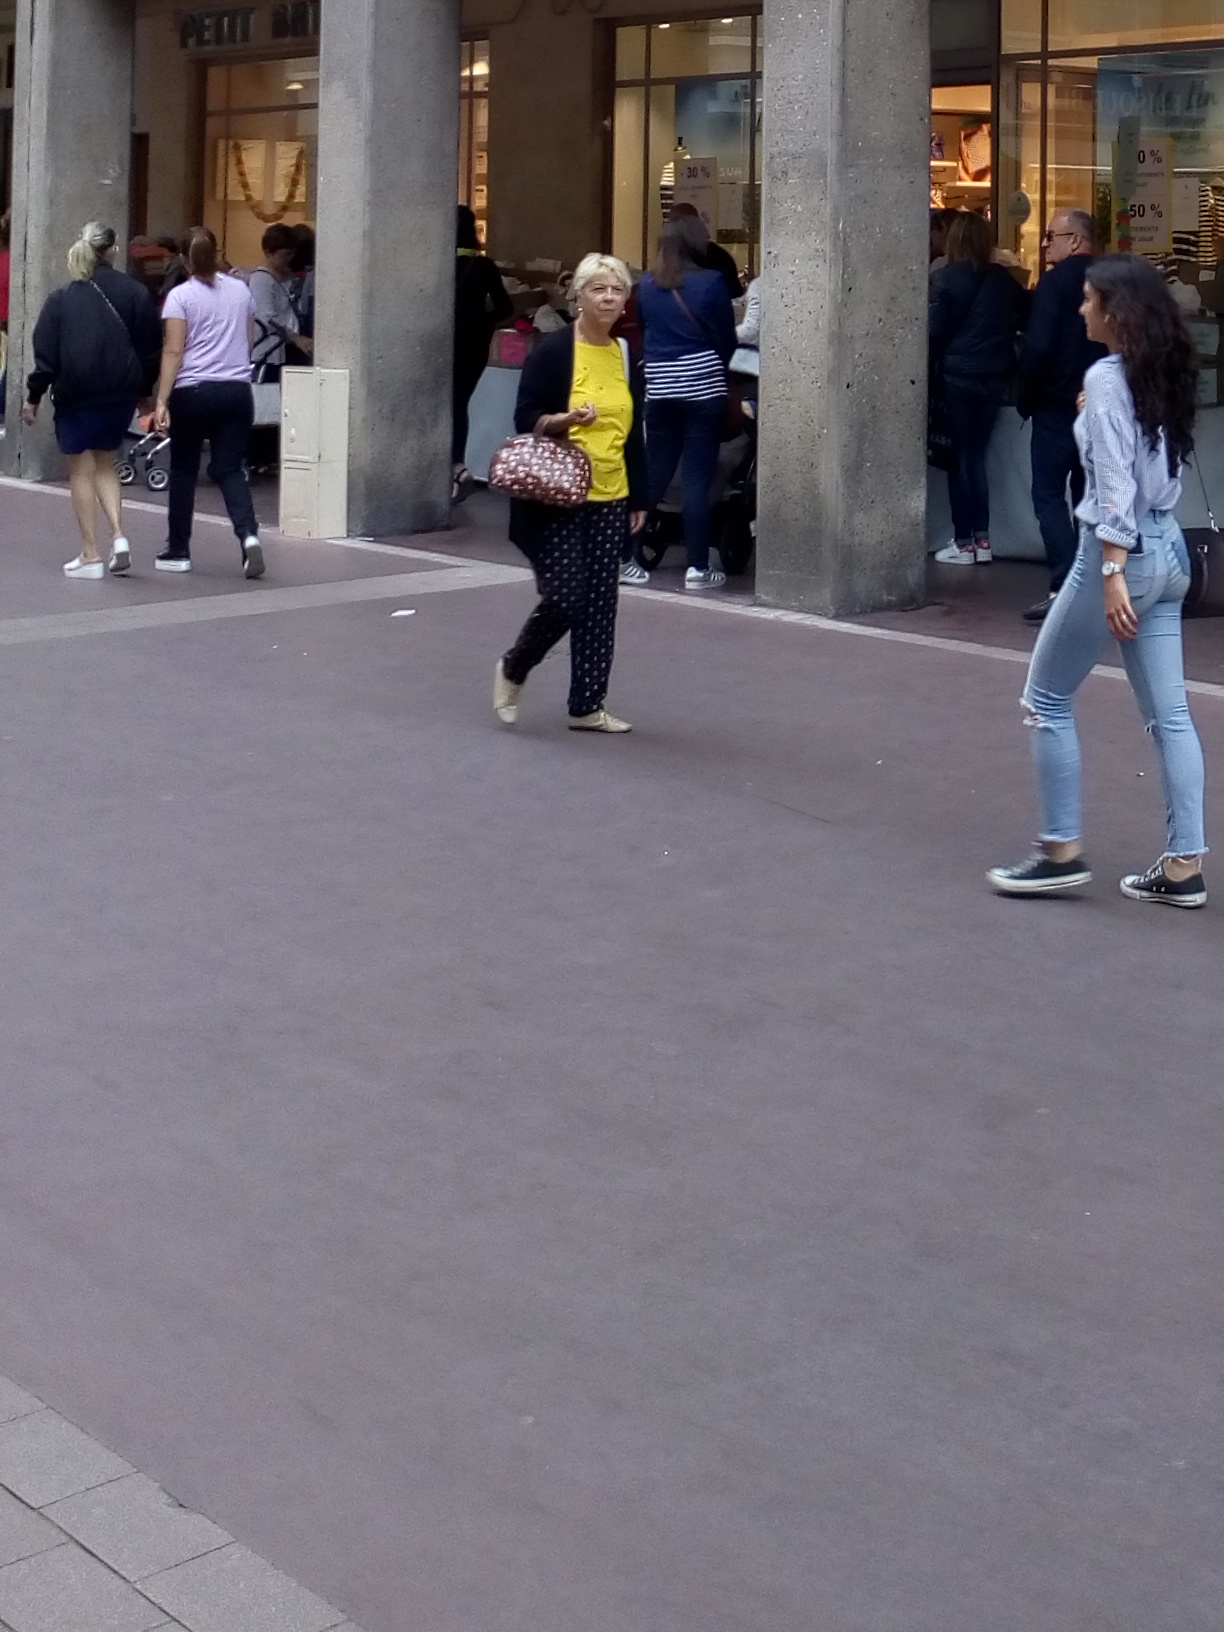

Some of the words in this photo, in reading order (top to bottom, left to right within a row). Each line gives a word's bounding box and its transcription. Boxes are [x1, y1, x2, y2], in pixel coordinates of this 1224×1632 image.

[1150, 149, 1163, 164] %
[1129, 204, 1146, 218] 50
[1150, 203, 1163, 218] %
